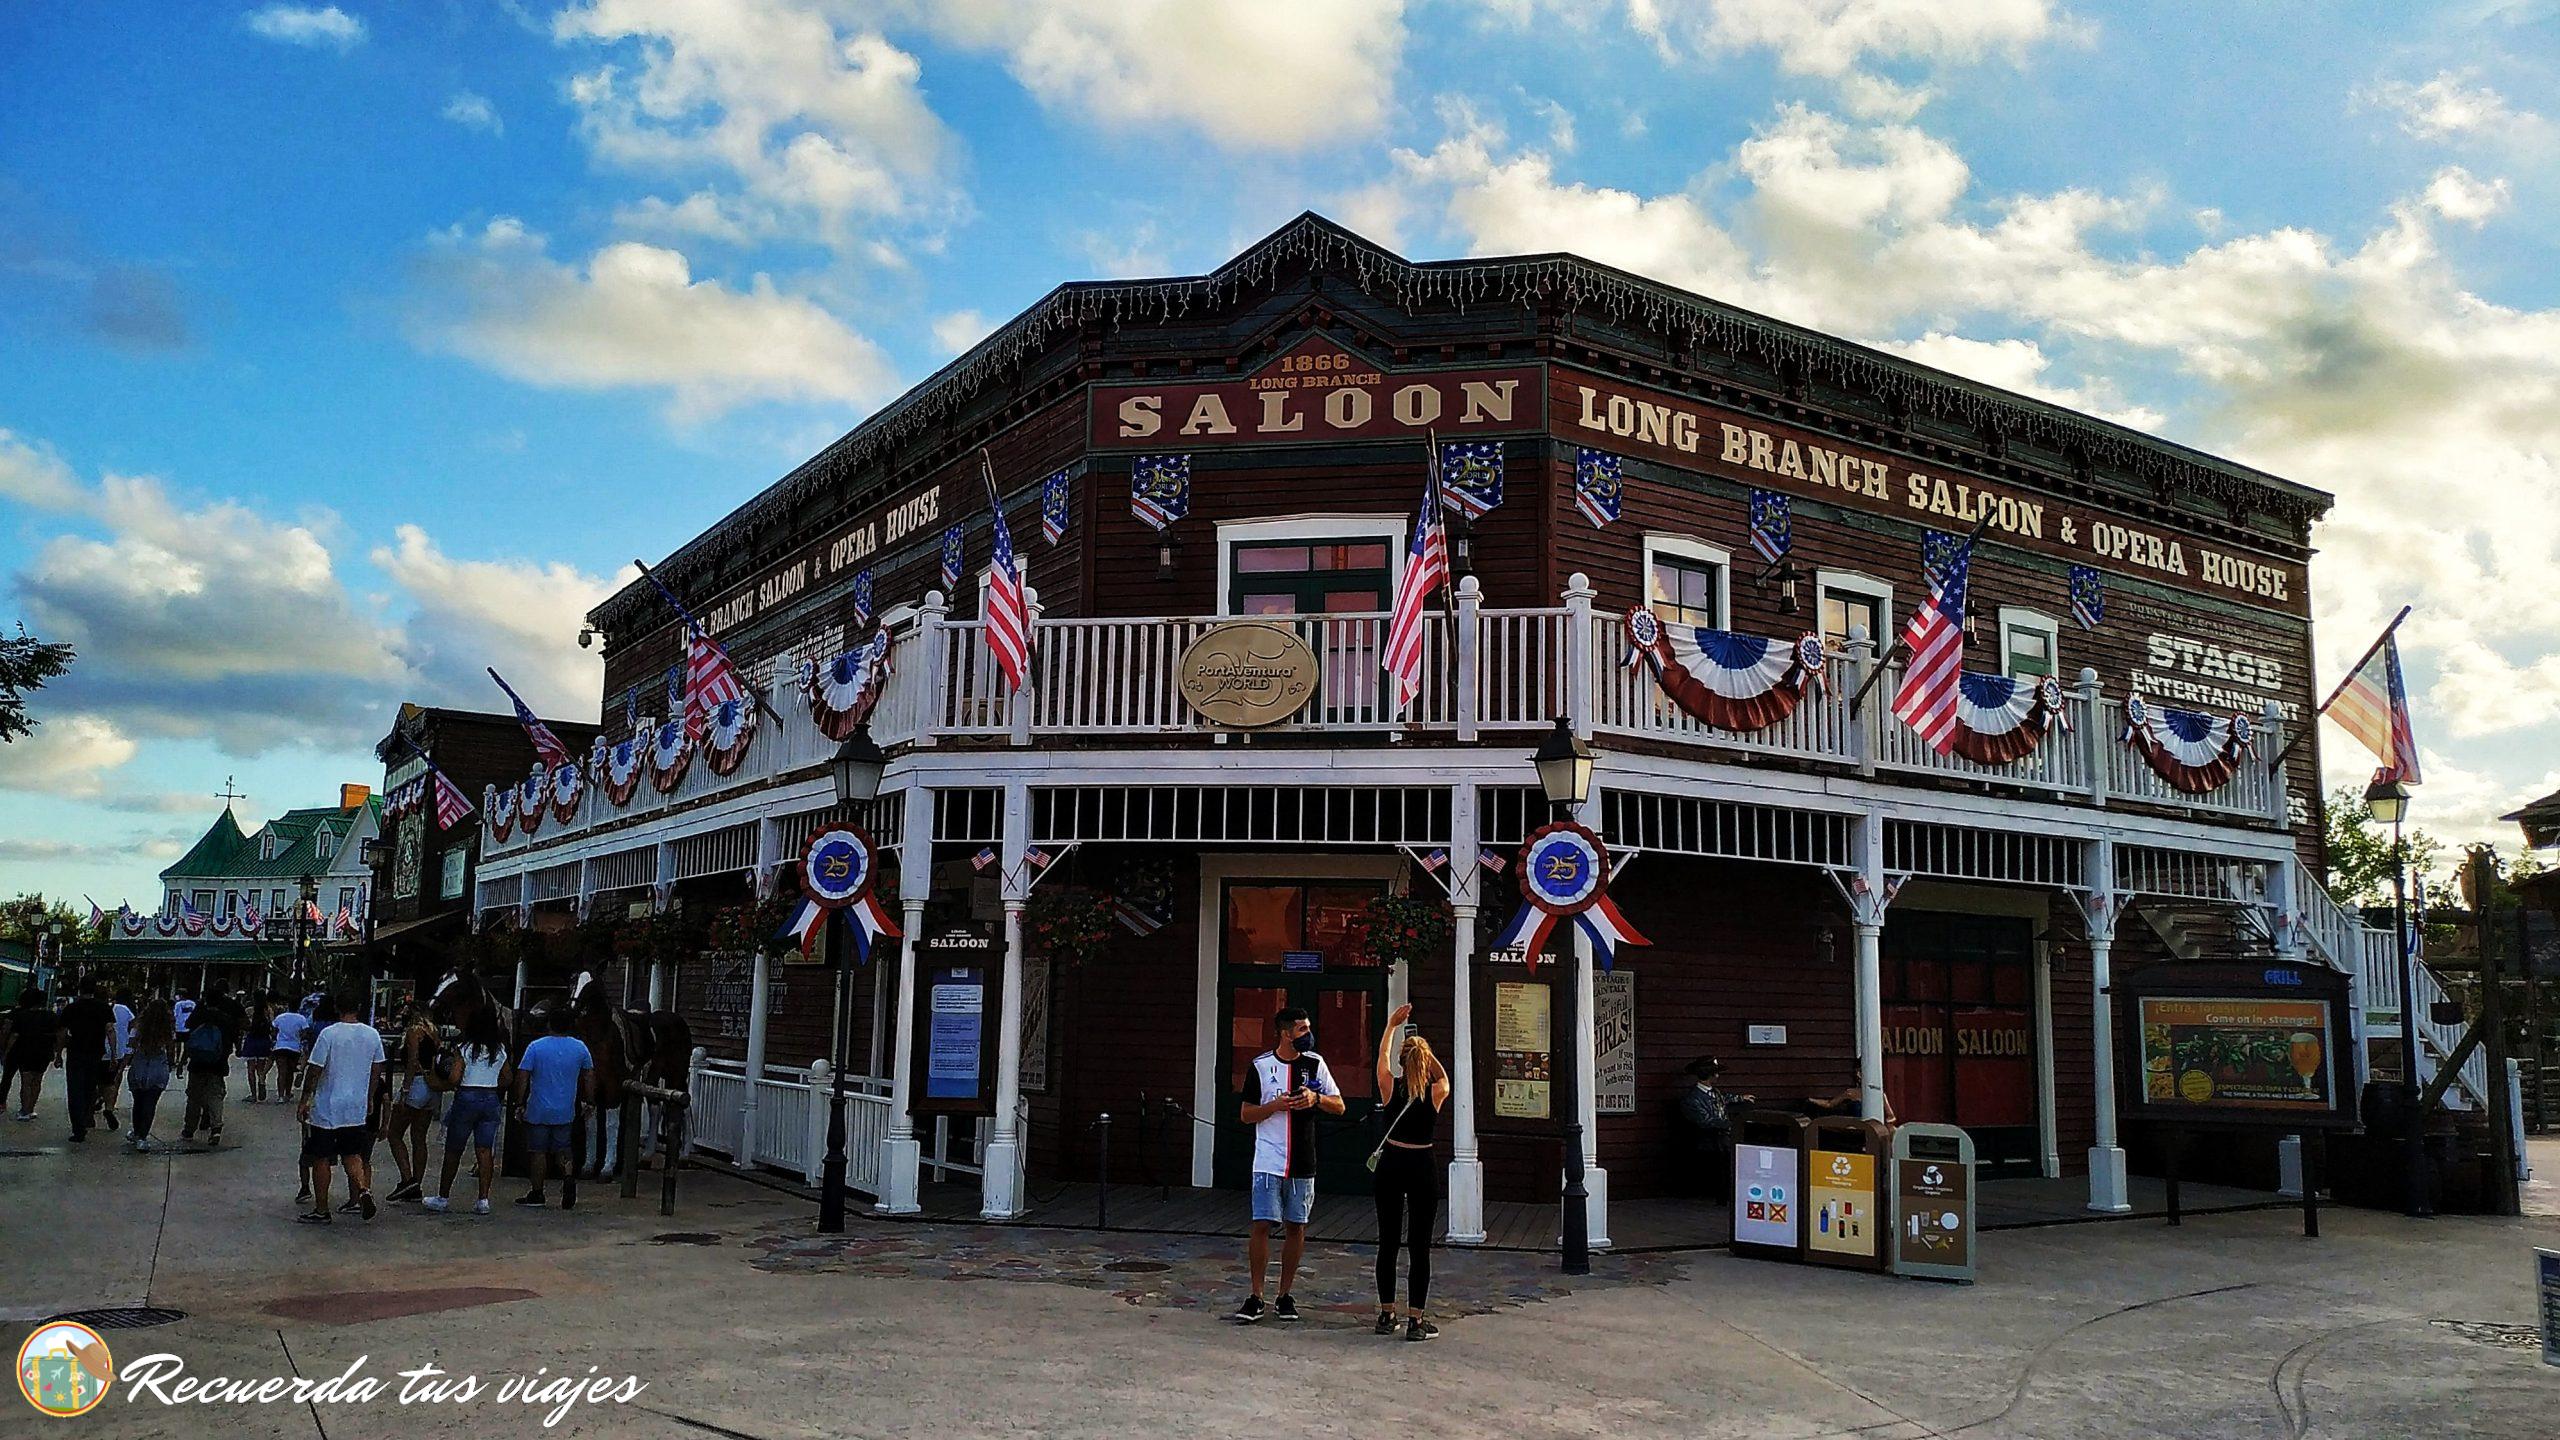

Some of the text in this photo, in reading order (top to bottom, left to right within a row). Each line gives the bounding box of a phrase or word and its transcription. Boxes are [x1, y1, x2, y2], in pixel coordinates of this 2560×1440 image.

[1281, 353, 1350, 373] 1866
[1249, 373, 1381, 391] LONG BRANCH
[1118, 379, 1520, 438] SALOON
[1578, 386, 2289, 601] LONG BRANCH SALOON & OPERA HOUSE
[709, 589, 754, 636] BRANCH
[758, 560, 807, 612] SALOON
[814, 556, 822, 579] &
[830, 522, 876, 574] OPERA
[886, 485, 940, 544] HOUSE
[1197, 664, 1293, 679] PortAventura
[2147, 633, 2283, 691] STAGE
[1218, 679, 1271, 690] WORLD
[2131, 668, 2299, 721] ENTERTAINMNT
[930, 938, 989, 949] SALOON
[2264, 969, 2303, 986] GRILL
[2205, 1013, 2235, 1024] Come
[2237, 1014, 2250, 1024] on
[2268, 1015, 2318, 1026] stranger!
[1881, 1026, 2028, 1056] ALOON SALOON
